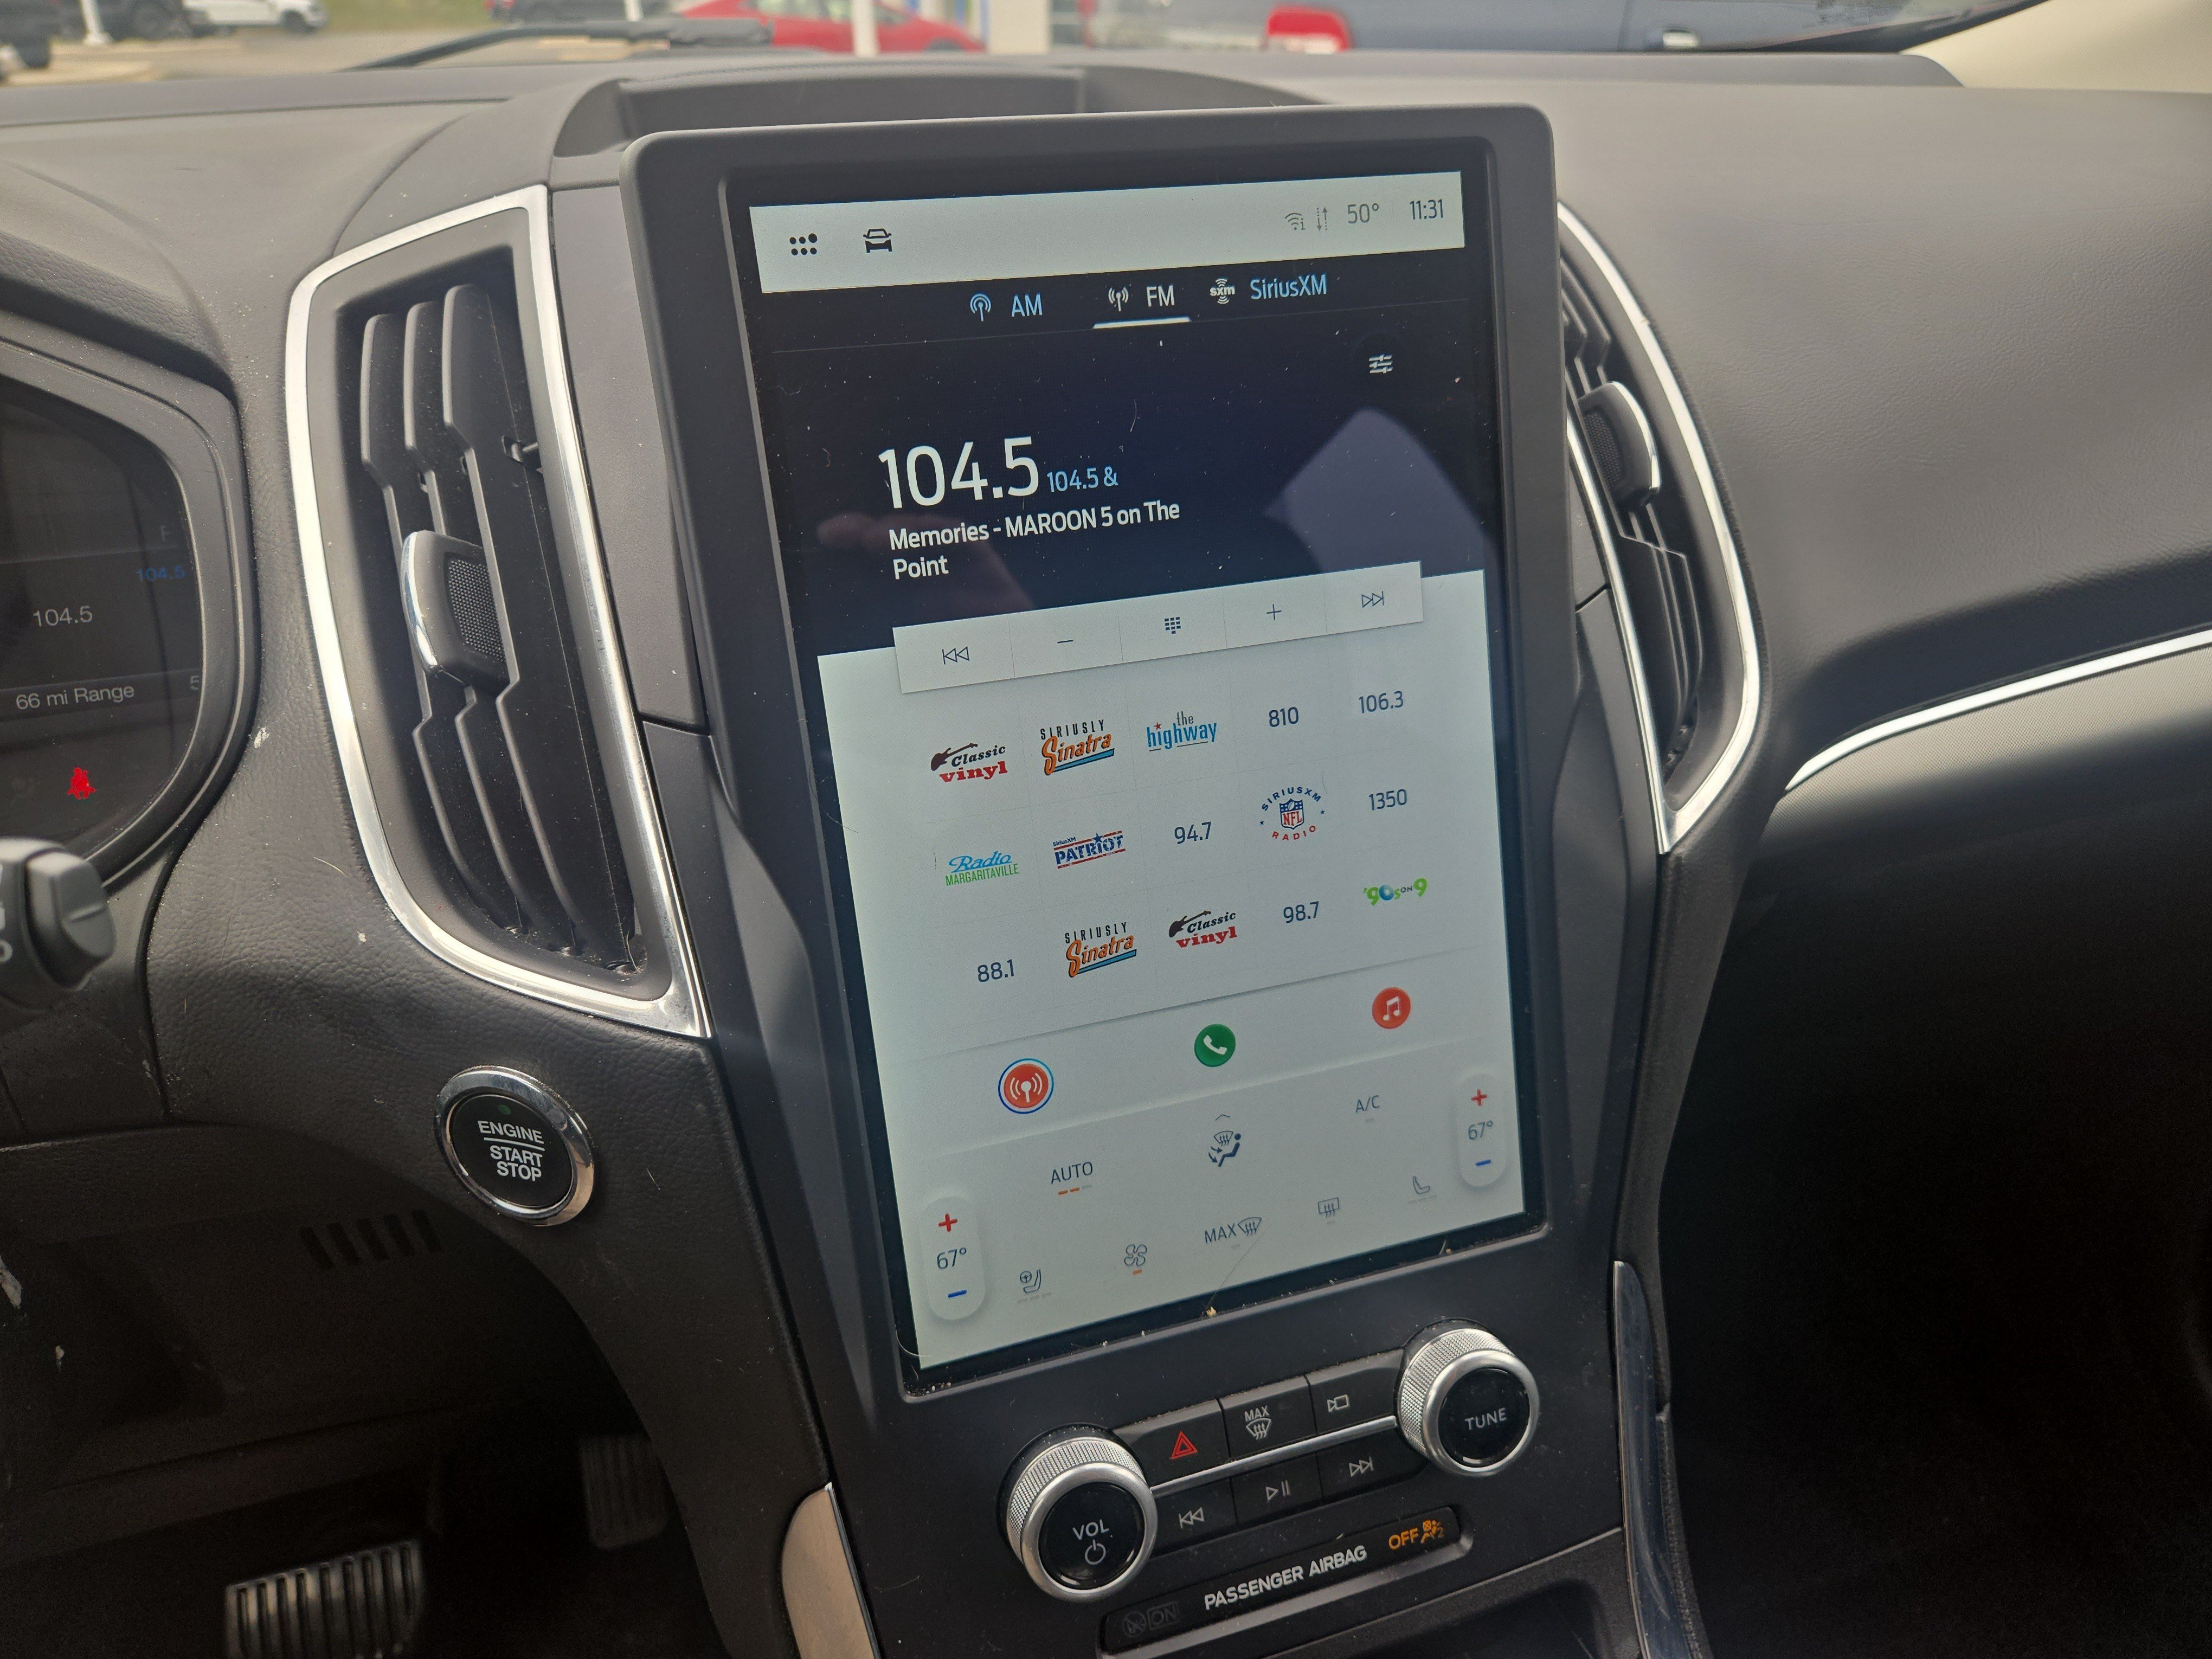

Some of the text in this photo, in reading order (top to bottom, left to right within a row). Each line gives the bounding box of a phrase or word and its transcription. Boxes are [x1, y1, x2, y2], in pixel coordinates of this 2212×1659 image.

[1410, 198, 1444, 220] 11:31
[1146, 285, 1175, 308] FM
[1250, 274, 1328, 300] SiriusXM
[1011, 293, 1043, 318] AM
[878, 436, 1039, 509] 104.5
[1046, 466, 1118, 492] 104.5 &
[889, 522, 989, 550] Memories
[1005, 507, 1097, 538] MAROON
[1101, 506, 1113, 528] 5
[1117, 510, 1141, 526] on
[1143, 500, 1180, 523] The
[135, 564, 186, 582] 104.5
[893, 555, 949, 580] Point
[33, 605, 93, 627] 104.5
[15, 685, 135, 710] 66 mi Range
[1358, 691, 1404, 713] 106.3
[1176, 711, 1194, 726] the
[1268, 706, 1299, 727] 810
[1040, 719, 1105, 741] SIRIUSLY
[1146, 722, 1217, 750] highway
[951, 745, 1006, 767] Classic
[1041, 734, 1112, 776] Sinatra
[939, 761, 1008, 782] vinyl
[1261, 787, 1321, 812] SIRIUSXM
[1368, 789, 1407, 811] 1350
[1282, 811, 1302, 826] NFL
[1052, 837, 1076, 847] SiriusXM
[1174, 821, 1212, 844] 94.7
[1271, 825, 1316, 841] RADIO
[1054, 835, 1123, 865] PATRIOT
[948, 850, 1012, 873] Radio
[945, 864, 1019, 886] MARGARITAVILLE
[1186, 911, 1236, 933] Classic
[1283, 901, 1320, 924] 98.7
[1064, 922, 1127, 944] SIRIUSLY
[1175, 926, 1238, 948] vinyl
[1065, 934, 1134, 978] Sinatra
[978, 959, 1015, 982] 88.1
[1355, 1095, 1380, 1113] A/C
[477, 1120, 544, 1144] ENGINE
[490, 1145, 543, 1167] START
[497, 1161, 542, 1182] STOP
[1051, 1161, 1094, 1184] AUTO
[1204, 1224, 1237, 1244] MAX
[1244, 1405, 1270, 1422] MAX
[1464, 1407, 1507, 1431] TUNE
[1072, 1519, 1109, 1541] VOL
[1388, 1527, 1419, 1551] OFF
[1204, 1545, 1367, 1610] PASSENGER AIRBAG
